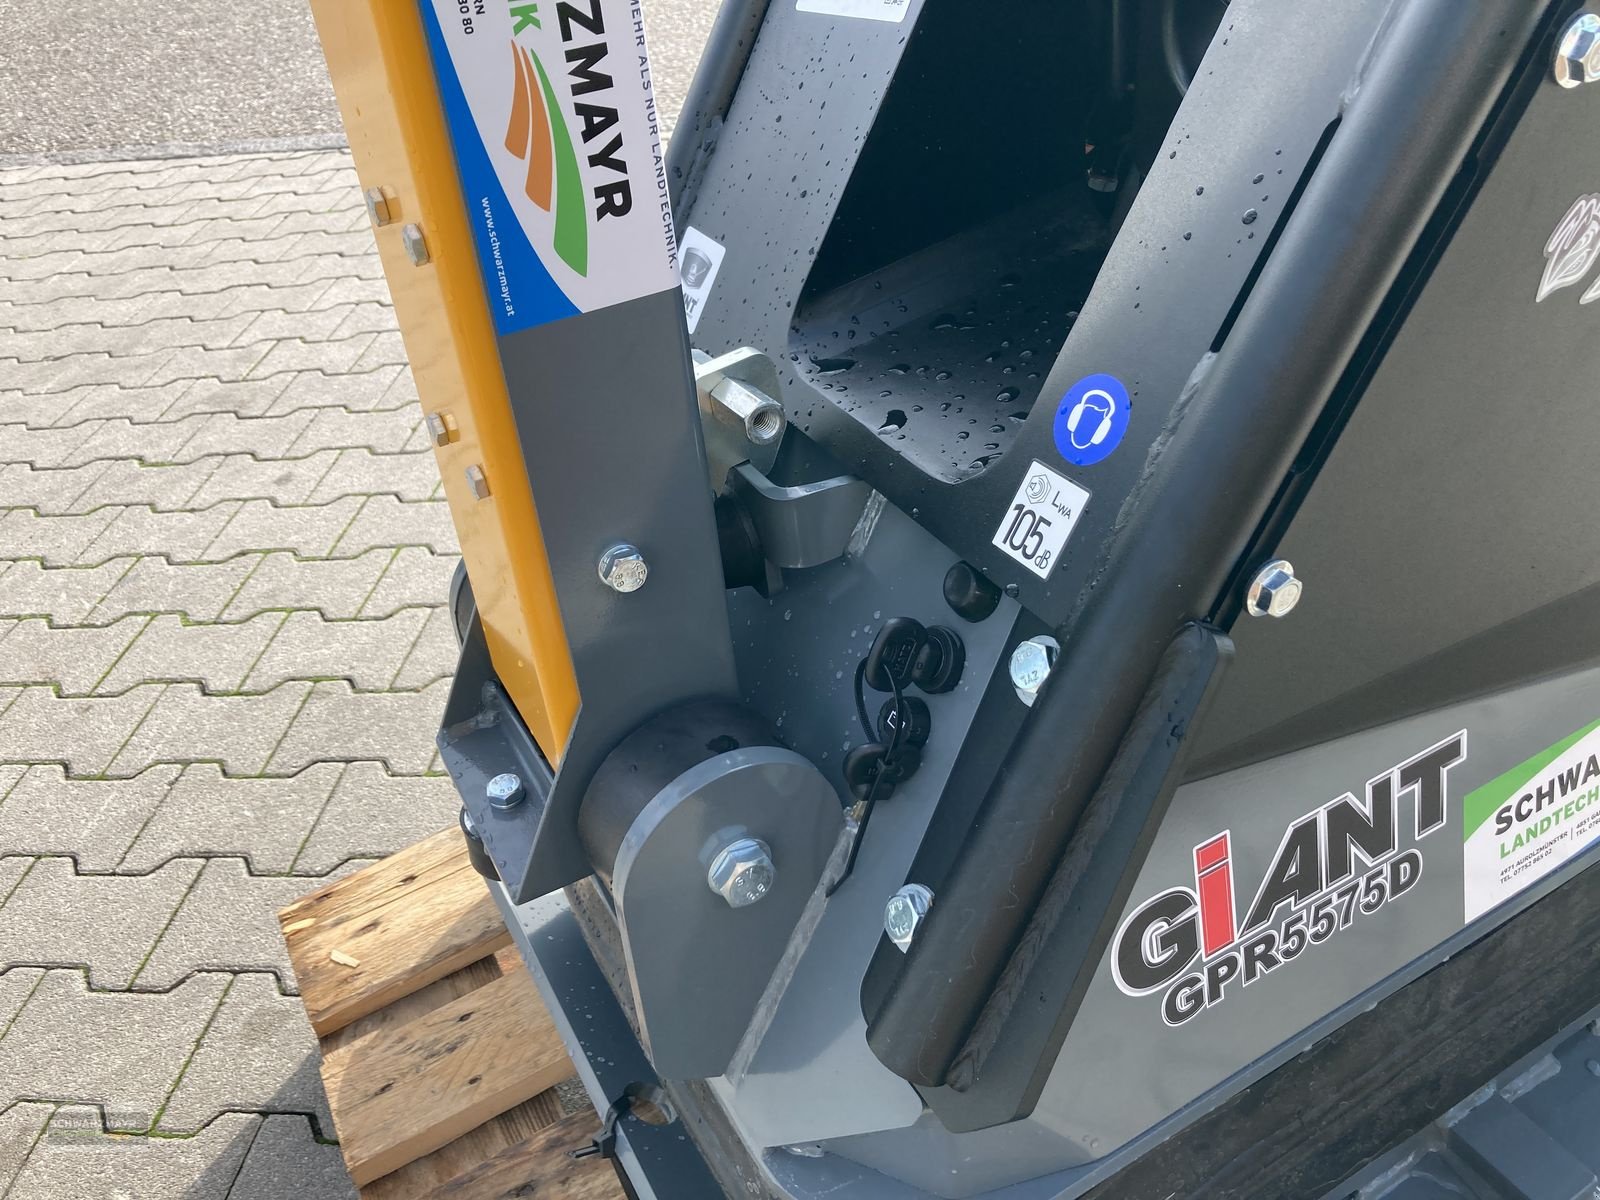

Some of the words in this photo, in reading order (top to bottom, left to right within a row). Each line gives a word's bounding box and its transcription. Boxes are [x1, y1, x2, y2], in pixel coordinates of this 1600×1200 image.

[462, 17, 474, 35] 80
[507, 0, 542, 37] K
[638, 55, 651, 91] ALS
[555, 0, 633, 222] ZMAYR
[645, 98, 658, 136] NUR
[651, 142, 678, 270] LANDTECHNIK.
[481, 196, 515, 317] www.schwarzmayr.at
[1002, 503, 1052, 560] 105
[1034, 549, 1052, 570] dB
[1494, 753, 1600, 836] SCHWA
[1500, 784, 1600, 859] LANDTECH
[1515, 831, 1568, 868] AUROLZMÜNSTER
[1161, 848, 1423, 1027] GPR5575D
